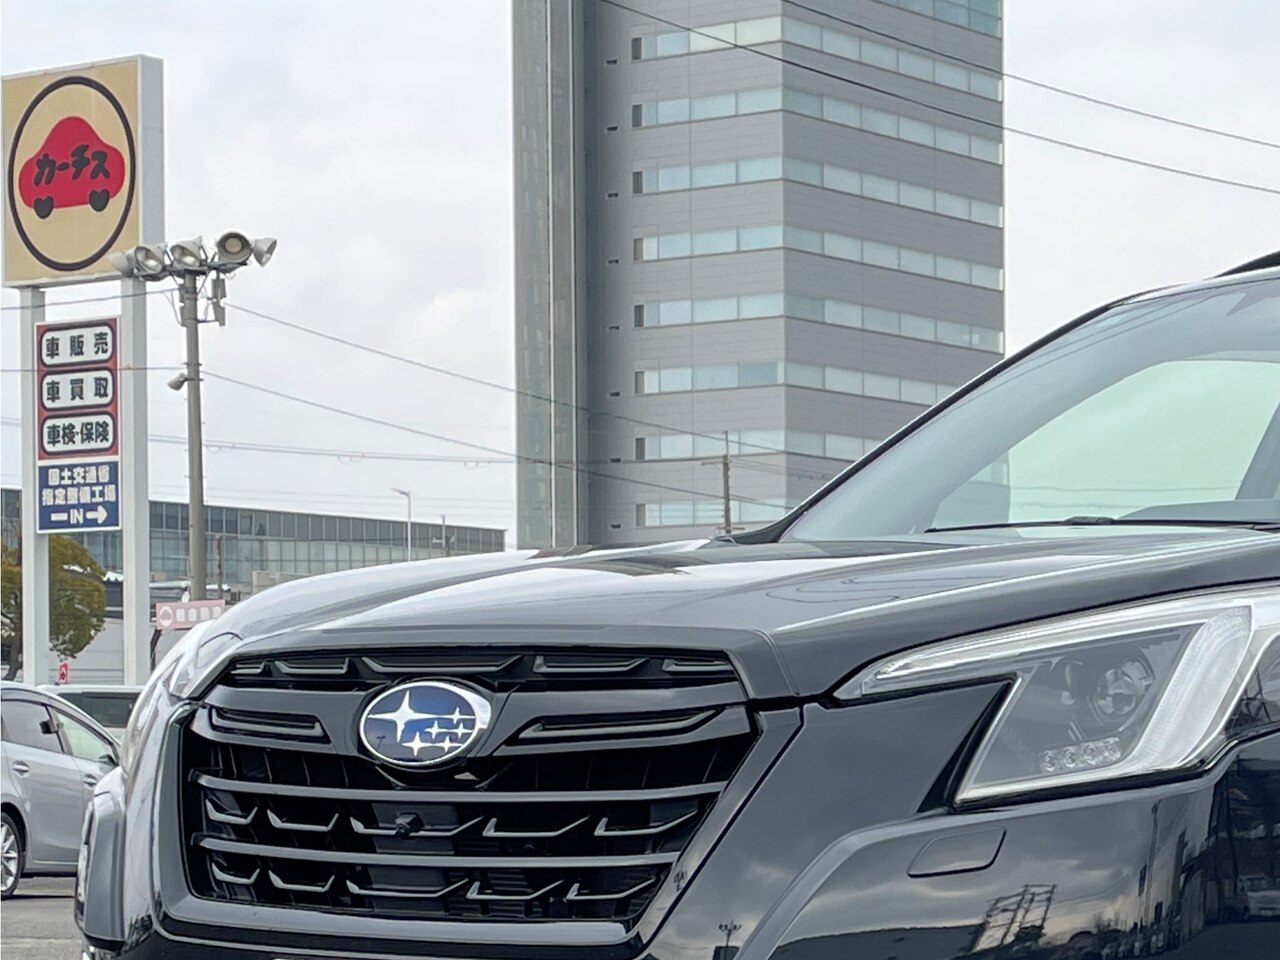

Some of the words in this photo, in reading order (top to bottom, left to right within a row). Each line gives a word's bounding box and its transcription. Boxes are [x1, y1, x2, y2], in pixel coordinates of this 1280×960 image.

[34, 144, 110, 186] カーチス
[46, 331, 109, 359] 車販売
[46, 376, 109, 403] 車買取
[69, 508, 84, 524] IN
